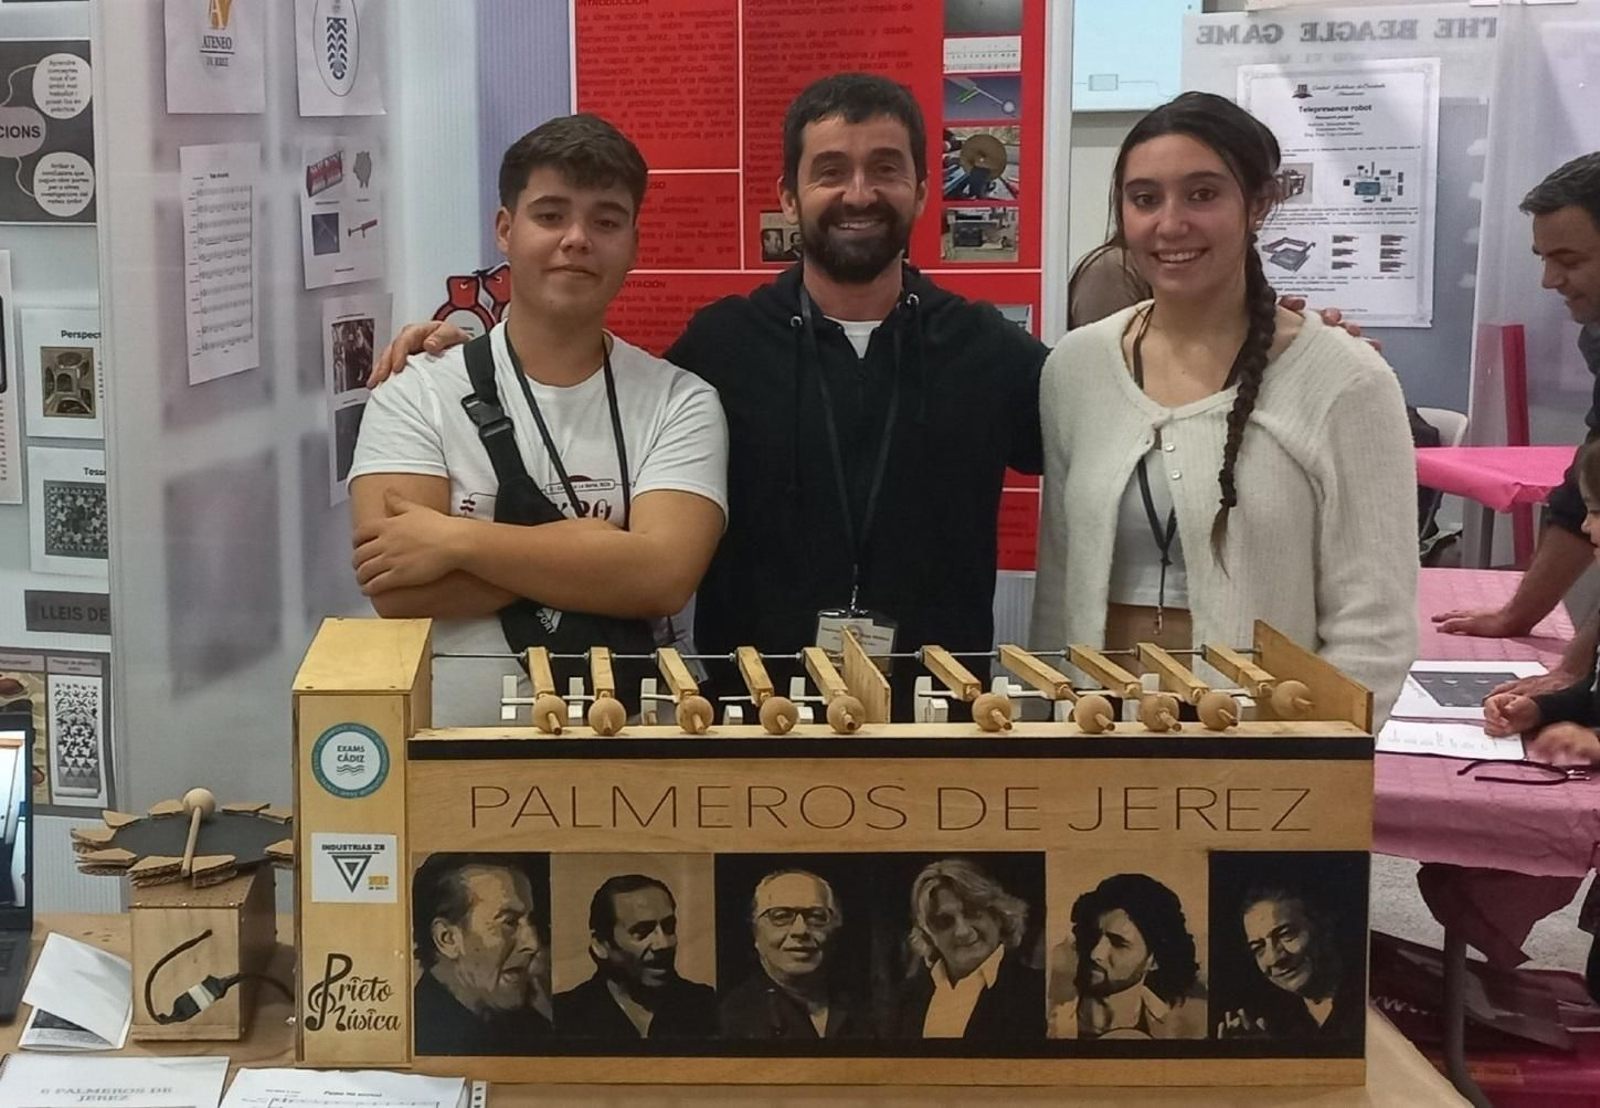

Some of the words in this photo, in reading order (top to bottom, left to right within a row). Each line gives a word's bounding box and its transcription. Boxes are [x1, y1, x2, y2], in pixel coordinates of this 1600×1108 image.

[1299, 105, 1349, 115] Telepresence
[1350, 104, 1372, 113] robot
[40, 605, 83, 621] LLEIS
[87, 607, 108, 622] DE
[337, 753, 365, 763] CÁDIZ
[470, 784, 907, 831] PALMEROS
[936, 785, 1041, 832] DE
[1067, 785, 1312, 832] JEREZ
[55, 1087, 146, 1095] PALMEROS
[78, 1095, 130, 1103] JEREZ
